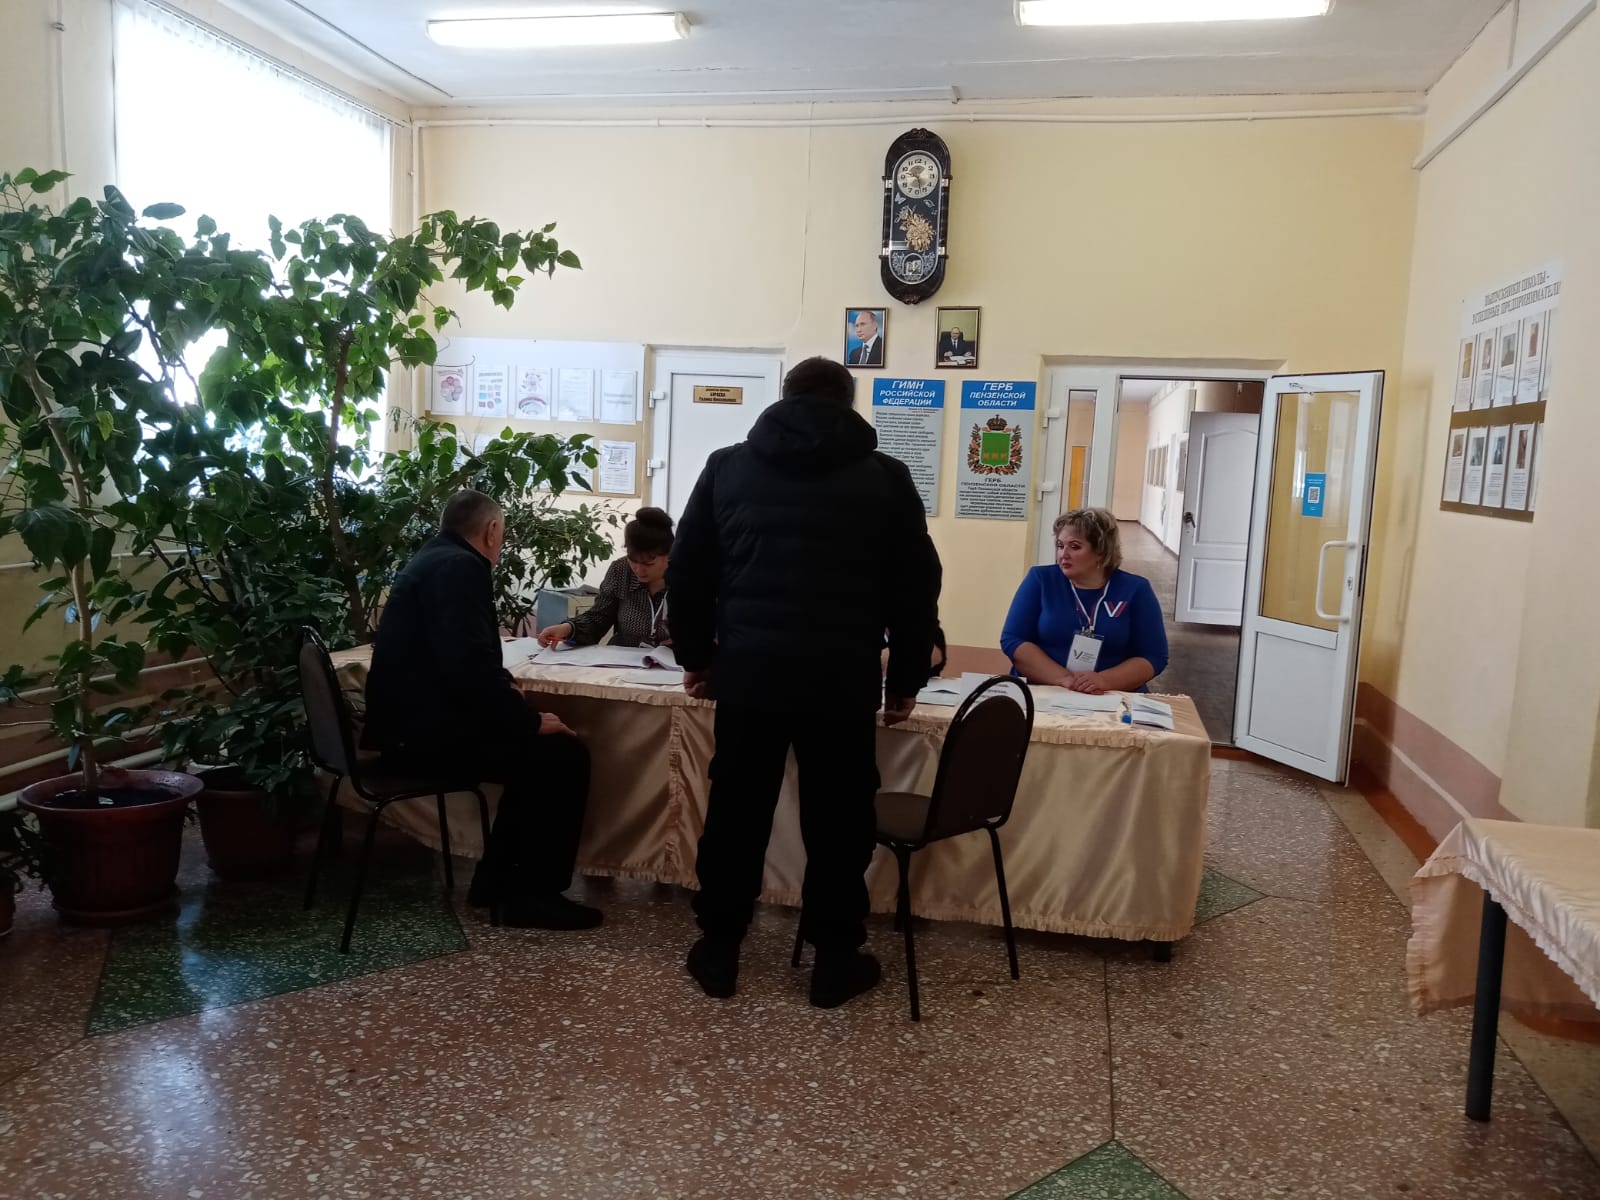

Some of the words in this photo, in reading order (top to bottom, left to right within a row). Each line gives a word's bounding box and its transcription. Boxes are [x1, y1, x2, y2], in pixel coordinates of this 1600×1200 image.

[892, 380, 925, 390] ГИМН
[982, 382, 1014, 391] ГЕРБ
[879, 389, 936, 398] РОССИЙСКОЙ
[969, 391, 1026, 399] ПЕНЗЕНСКОЙ
[882, 397, 933, 406] ФЕДЕРАЦИИ
[977, 399, 1017, 407] ОБЛАСТИ
